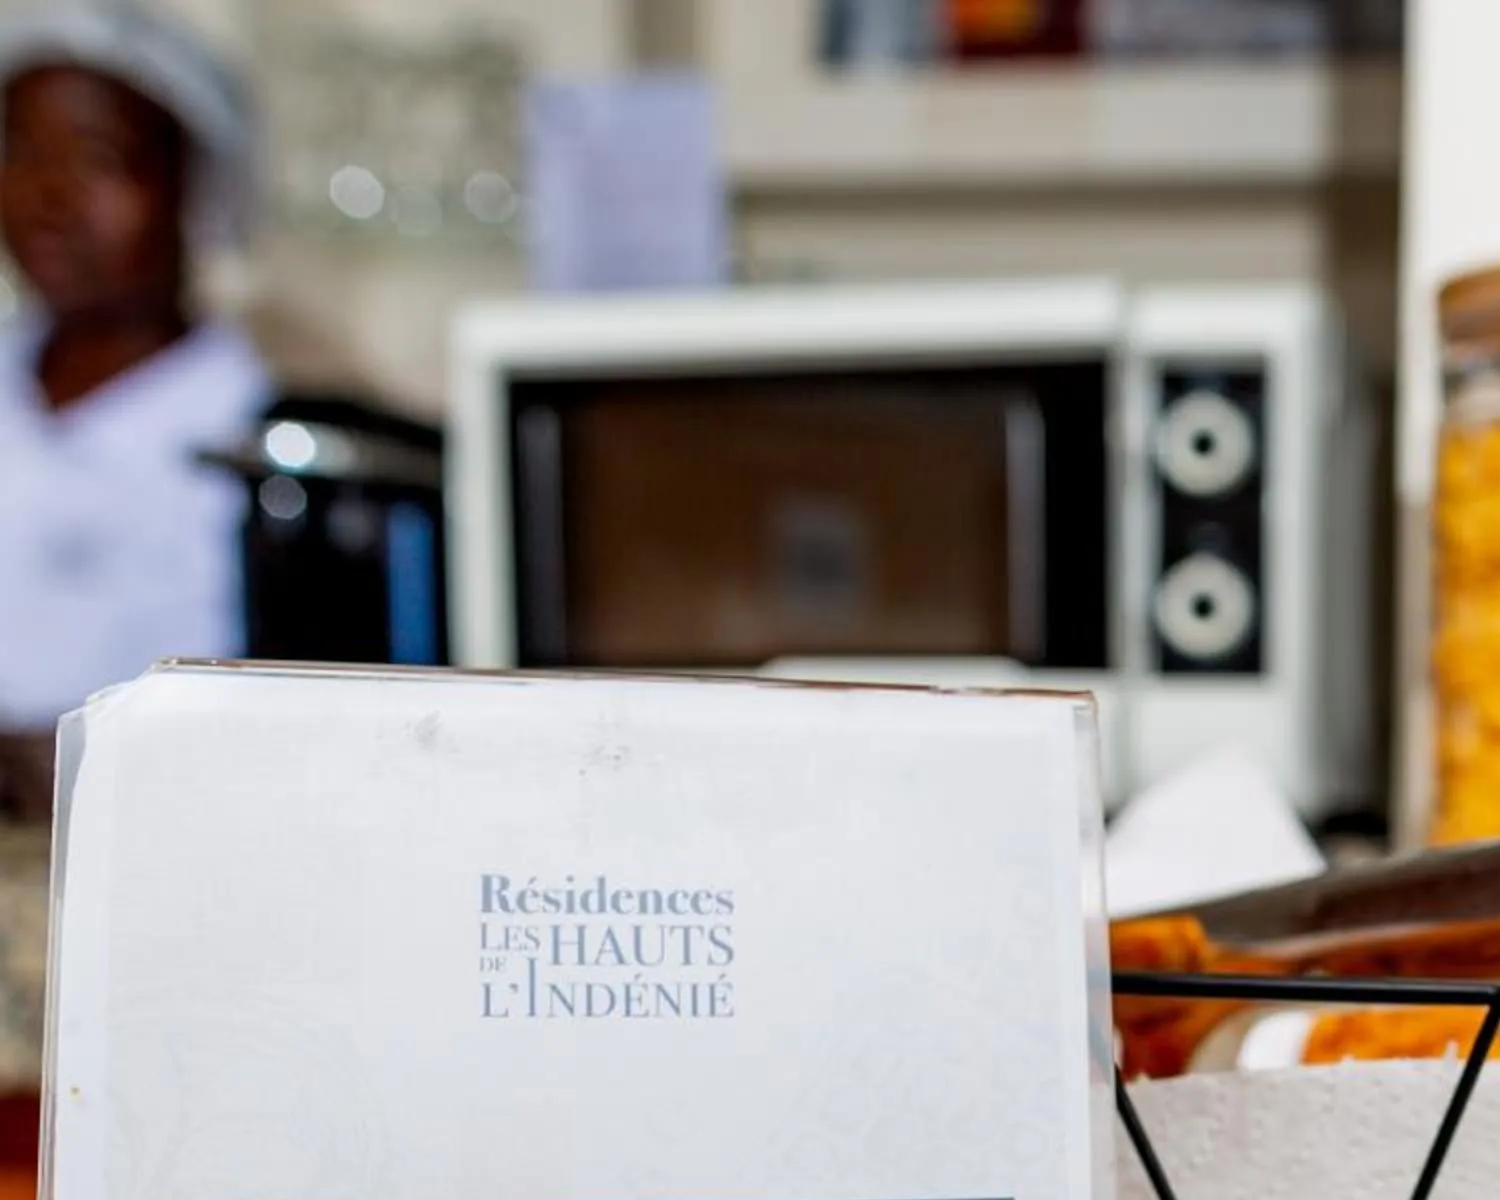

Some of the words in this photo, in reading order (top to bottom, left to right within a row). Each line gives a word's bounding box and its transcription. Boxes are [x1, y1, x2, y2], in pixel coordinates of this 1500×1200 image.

[479, 873, 735, 915] Résidences
[479, 922, 541, 950] LES
[549, 923, 735, 967] HAUTS
[479, 956, 506, 972] DE
